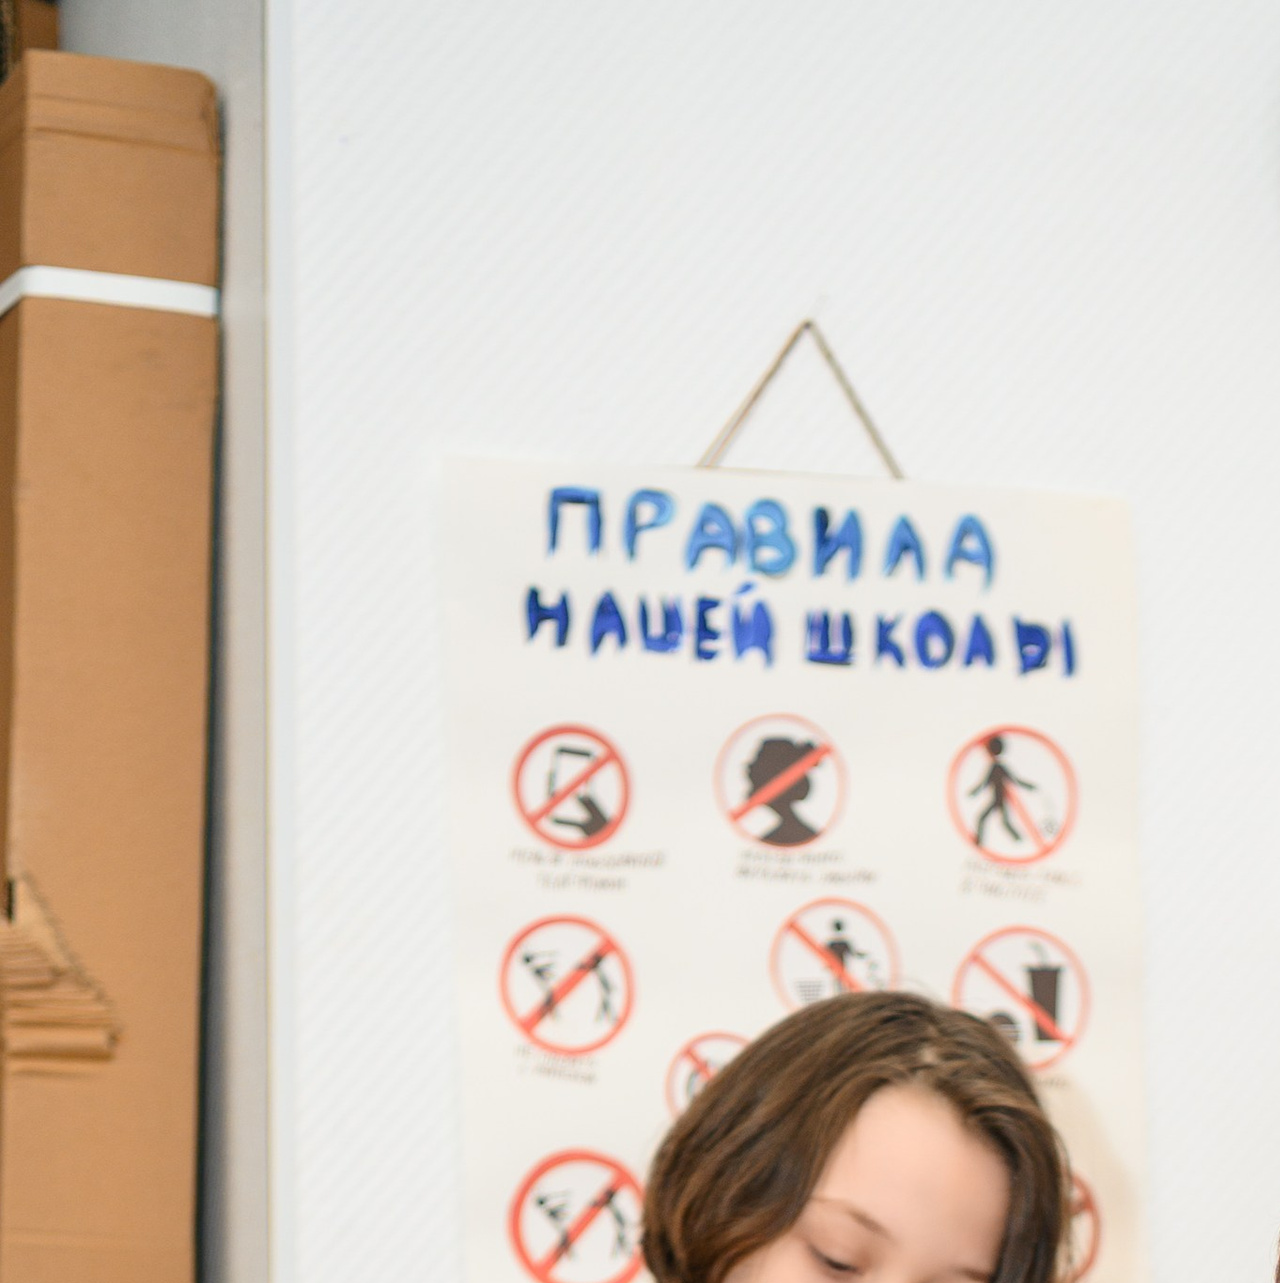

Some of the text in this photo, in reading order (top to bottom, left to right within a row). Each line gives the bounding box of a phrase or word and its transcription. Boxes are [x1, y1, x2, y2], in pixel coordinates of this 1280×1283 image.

[546, 485, 996, 590] ПРАВИЛА
[523, 581, 1077, 676] НАШЕЙ ШКОЛЫ
